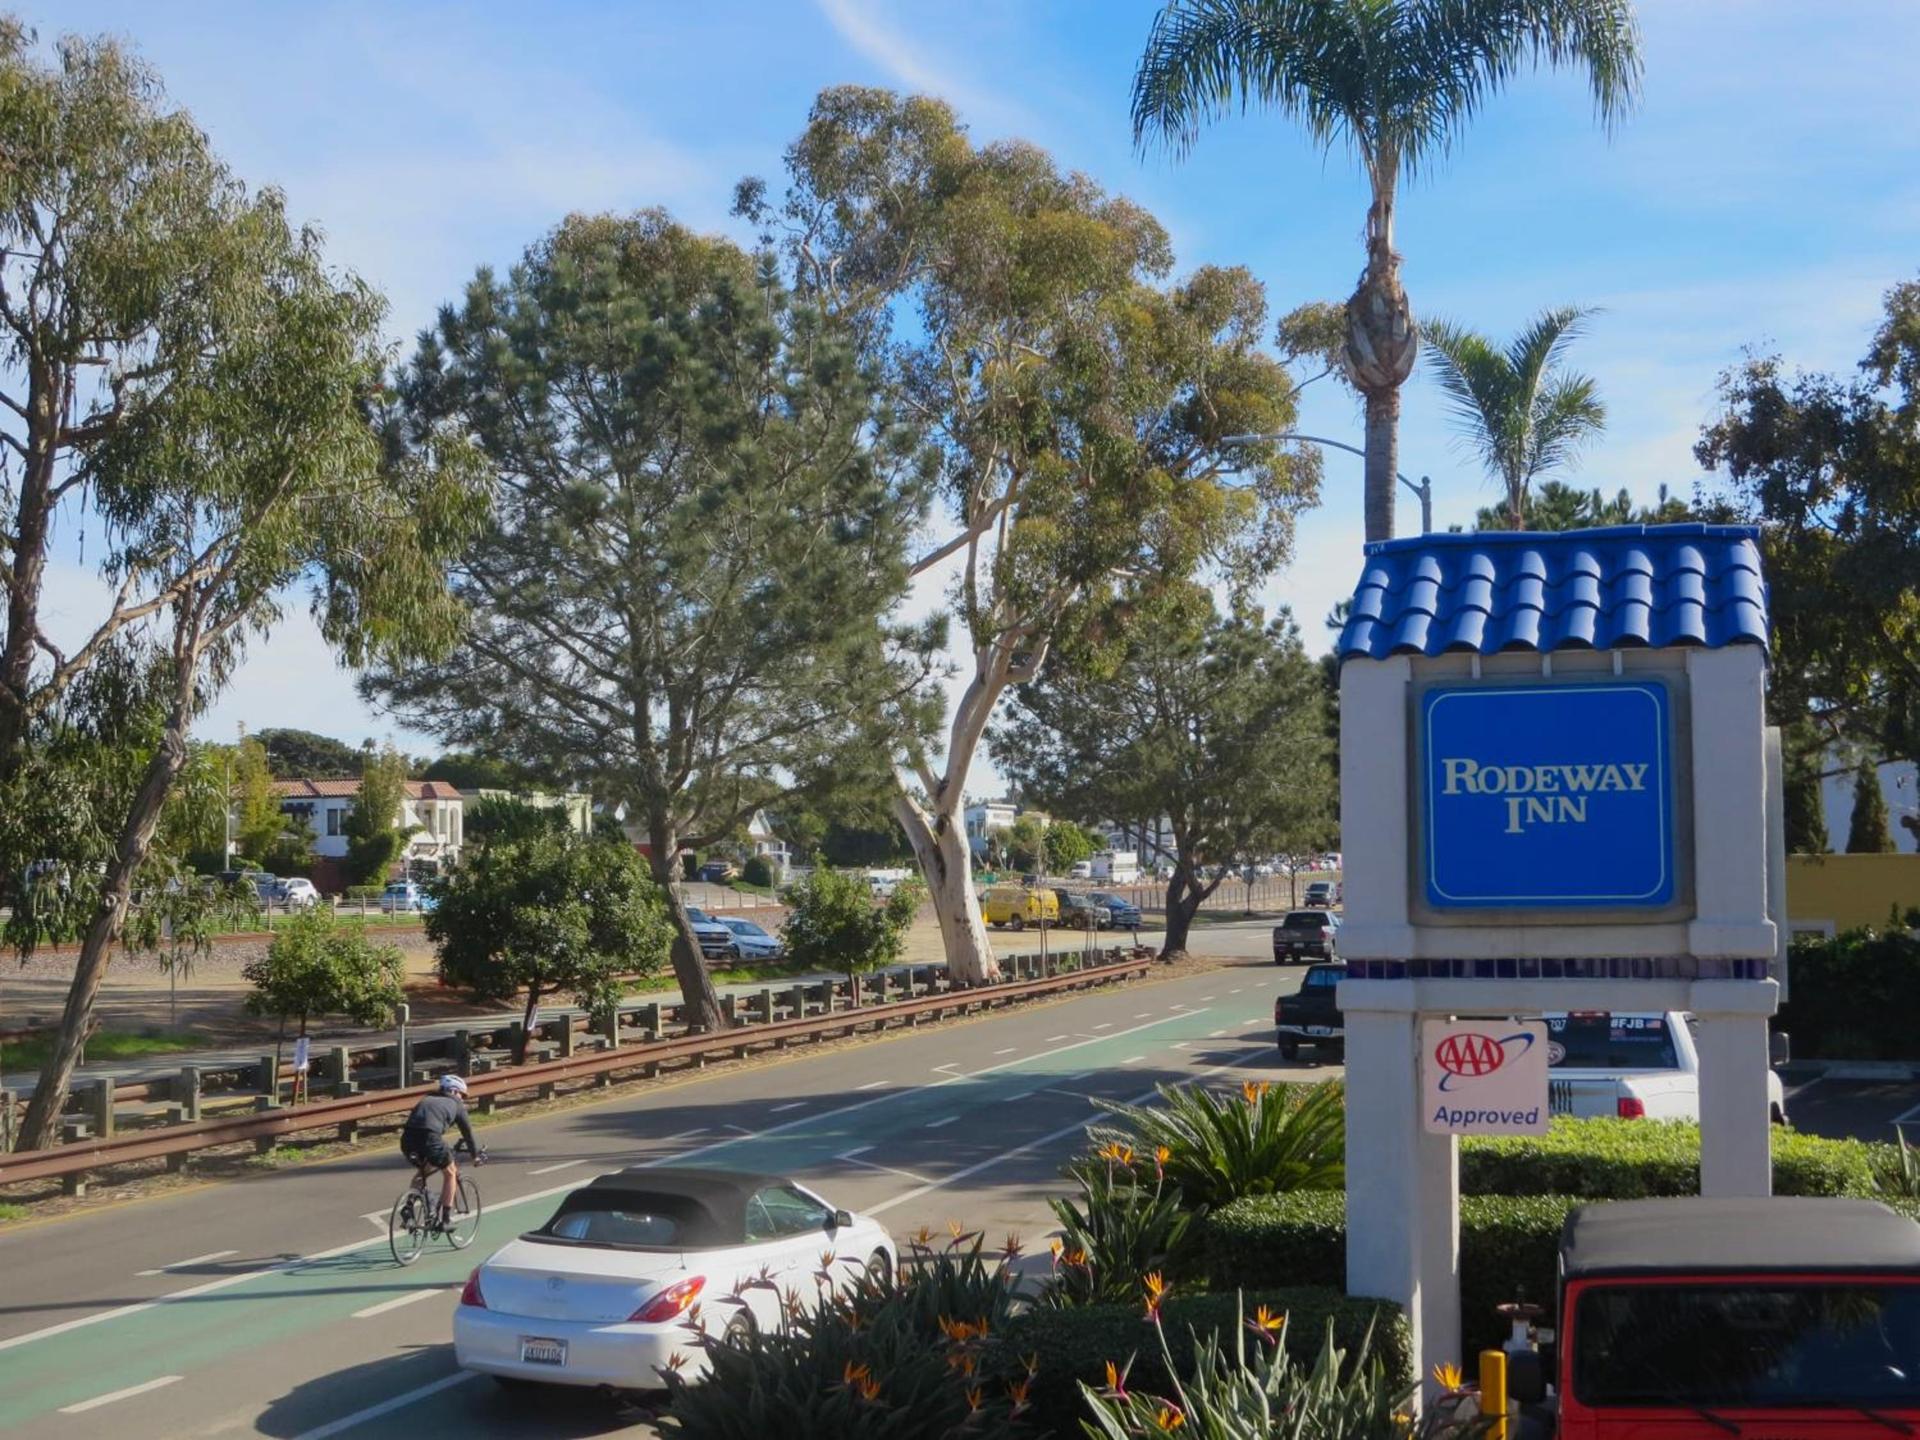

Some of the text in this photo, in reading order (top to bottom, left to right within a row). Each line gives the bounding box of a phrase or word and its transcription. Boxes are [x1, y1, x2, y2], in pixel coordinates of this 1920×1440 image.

[1441, 758, 1649, 794] RODEWAY
[1504, 796, 1588, 833] INN
[1442, 1034, 1498, 1076] AAA
[1433, 1106, 1539, 1127] Approved
